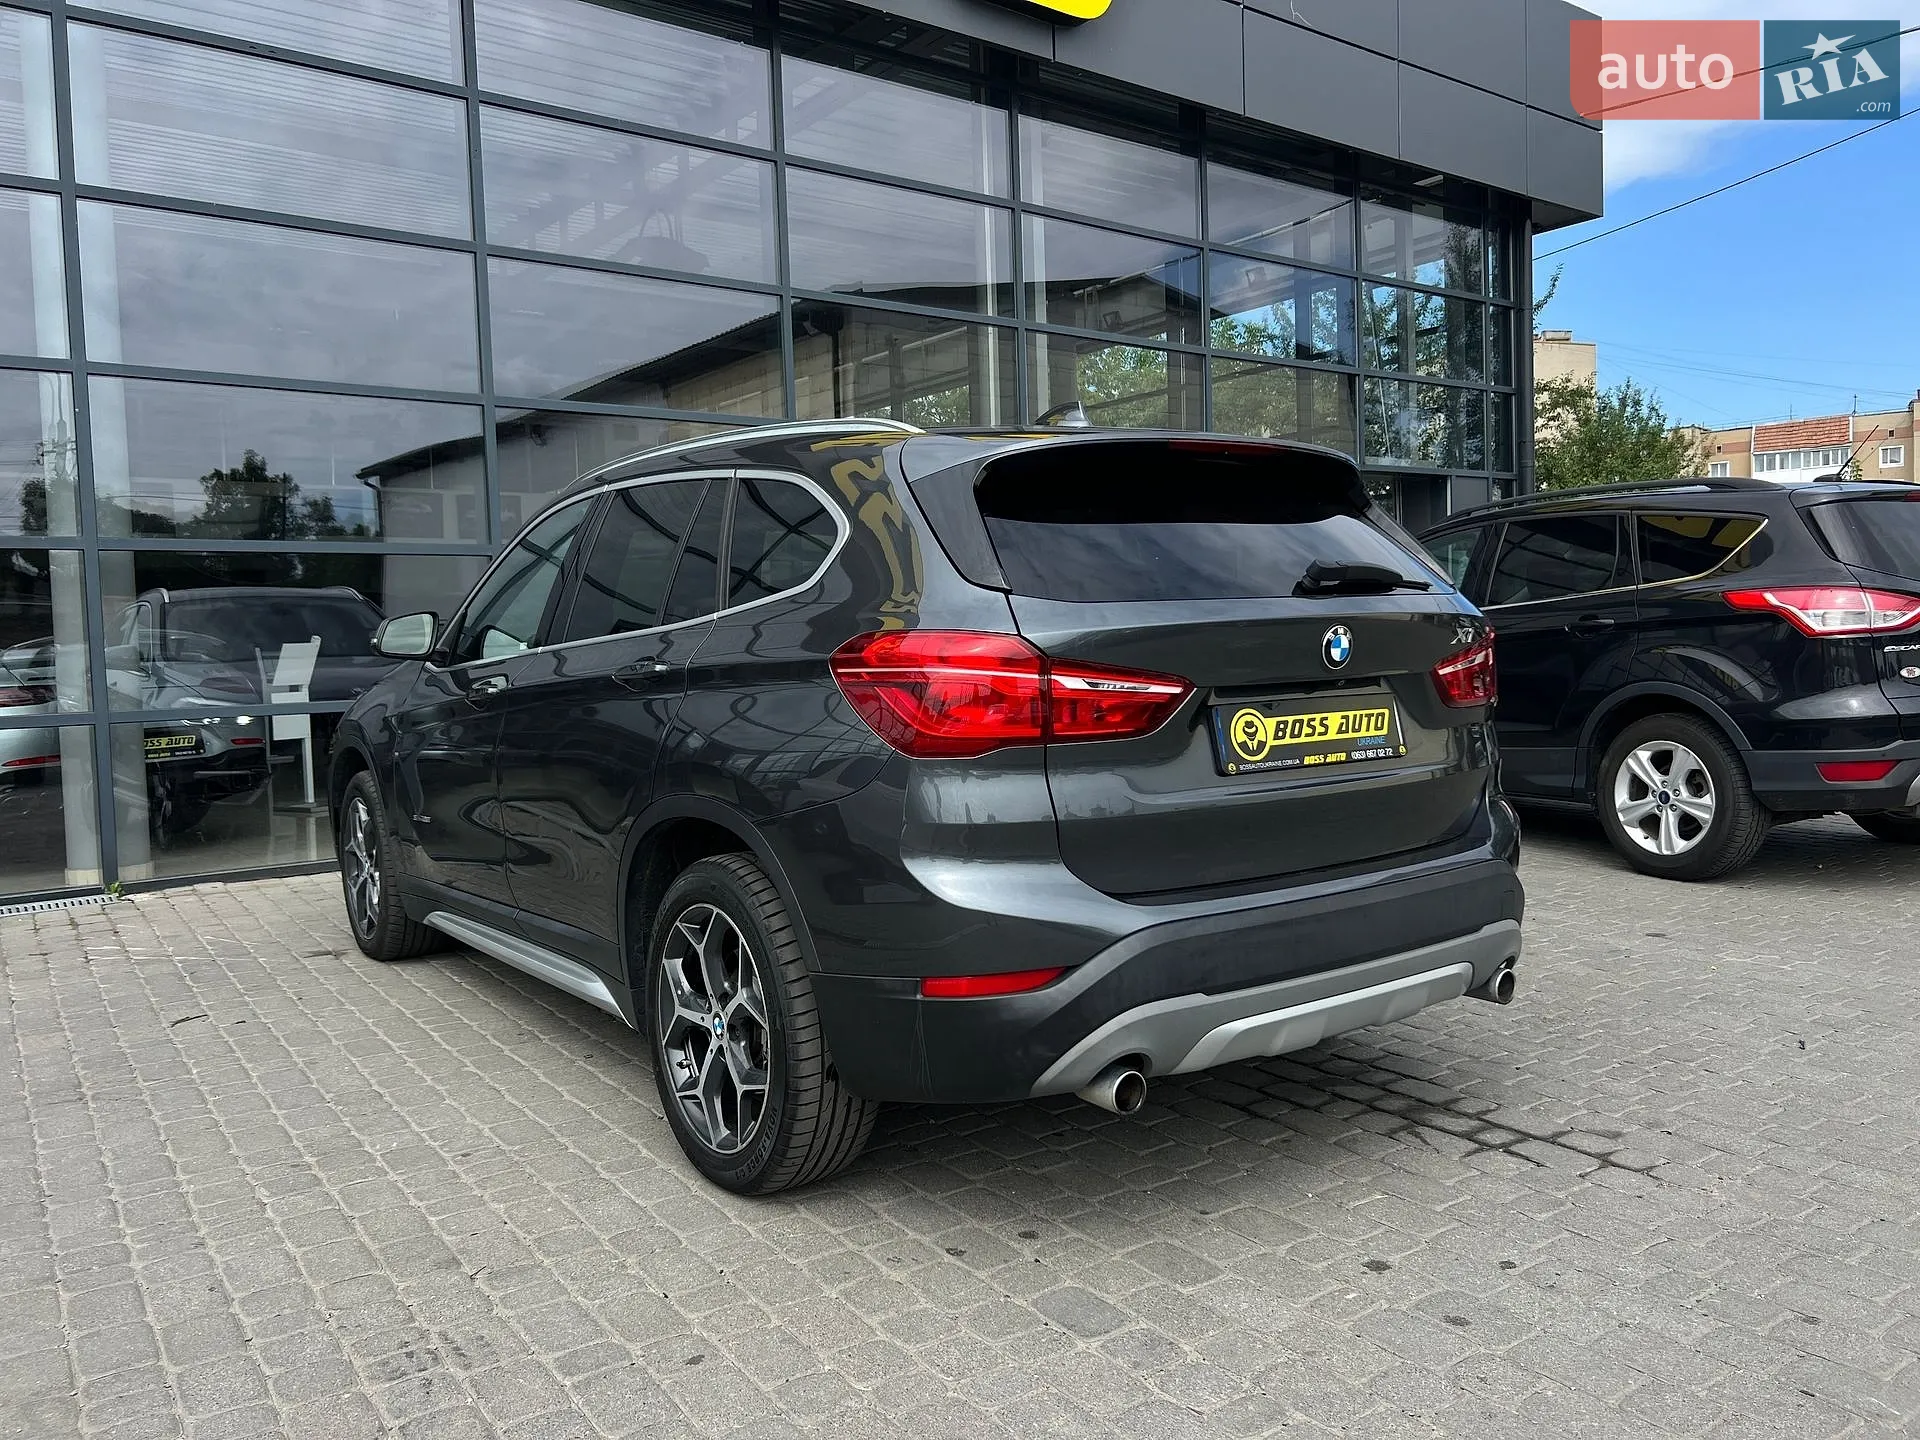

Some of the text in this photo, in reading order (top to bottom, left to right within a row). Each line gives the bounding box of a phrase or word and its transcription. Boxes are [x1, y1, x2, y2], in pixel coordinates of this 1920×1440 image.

[1272, 711, 1386, 741] BOSS AUTO
[165, 736, 194, 746] AUTO
[1357, 736, 1386, 746] UKRAINE
[1304, 752, 1347, 765] BOSS AUTO
